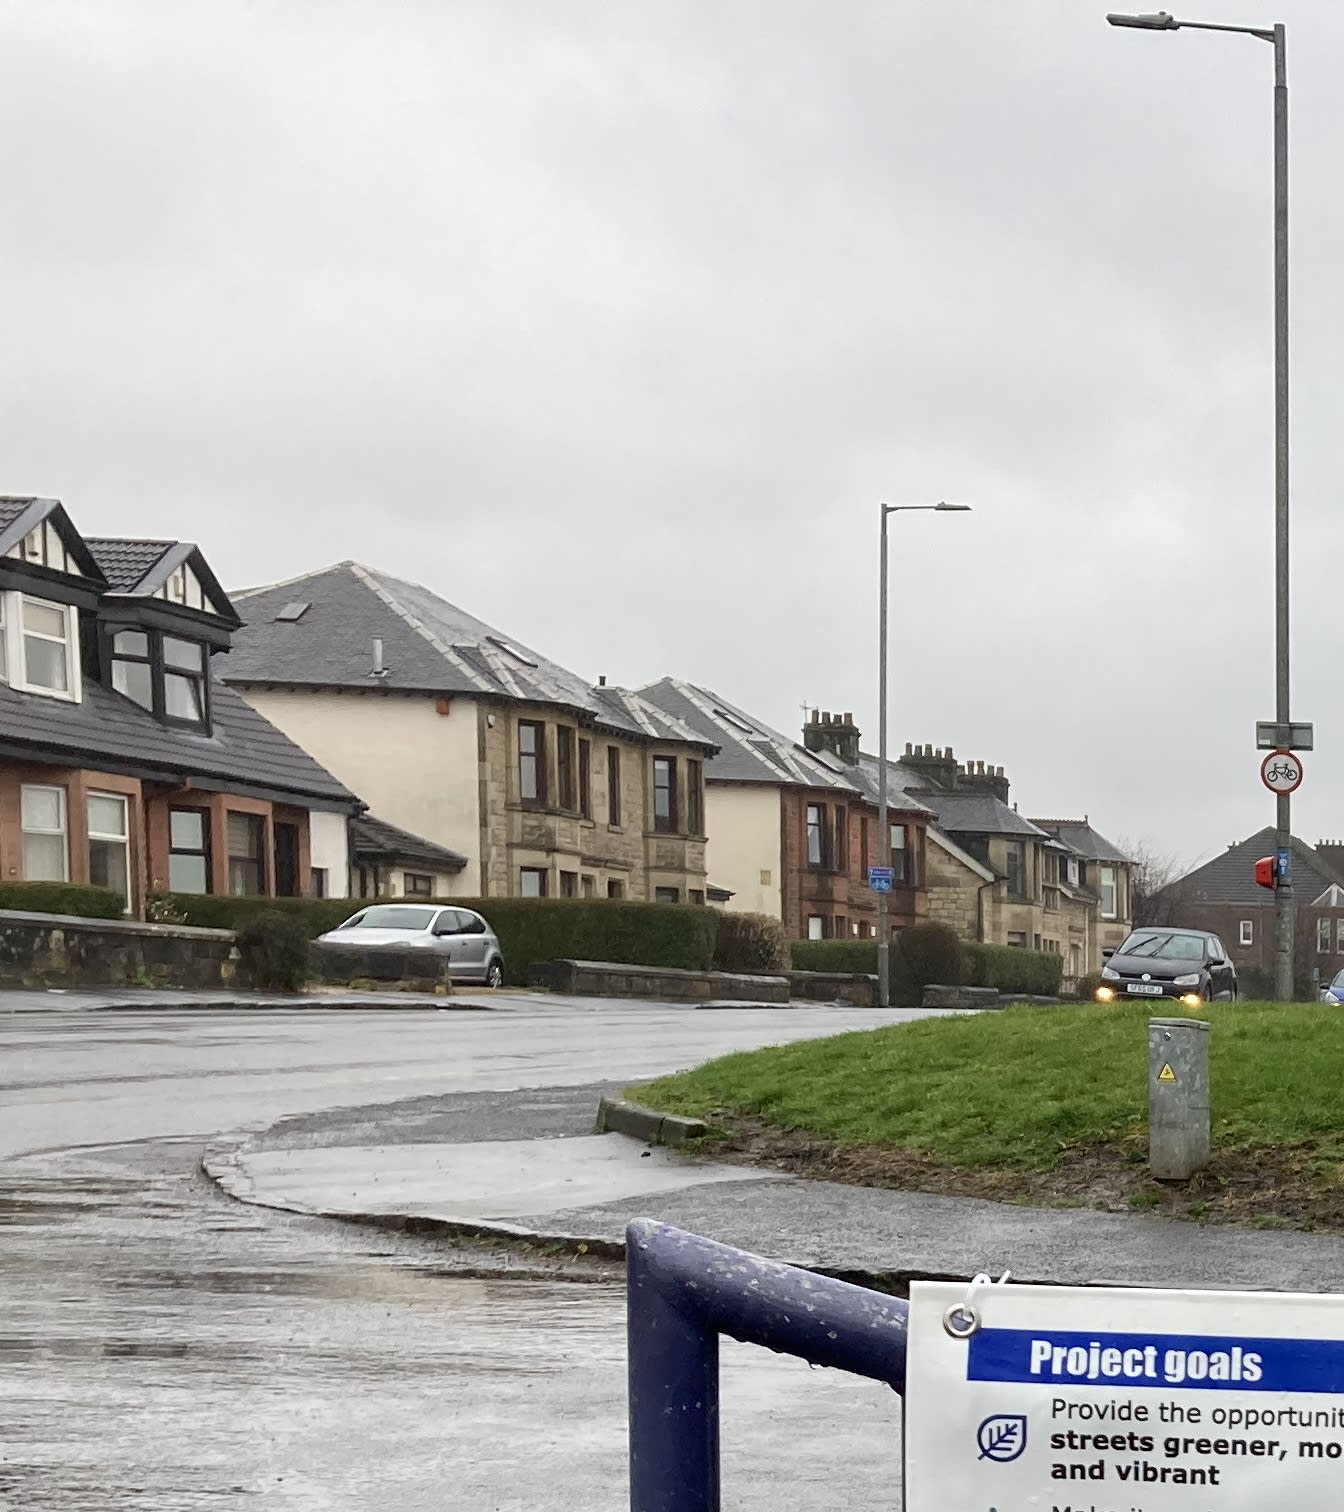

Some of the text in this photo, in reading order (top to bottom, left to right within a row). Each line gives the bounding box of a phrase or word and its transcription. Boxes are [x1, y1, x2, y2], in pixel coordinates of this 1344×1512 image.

[1029, 1339, 1263, 1384] Project goals
[1051, 1398, 1149, 1422] Provide
[1158, 1401, 1202, 1424] the
[1050, 1429, 1155, 1452] streets
[1163, 1436, 1288, 1462] greener,
[1050, 1459, 1221, 1486] and vibrant
